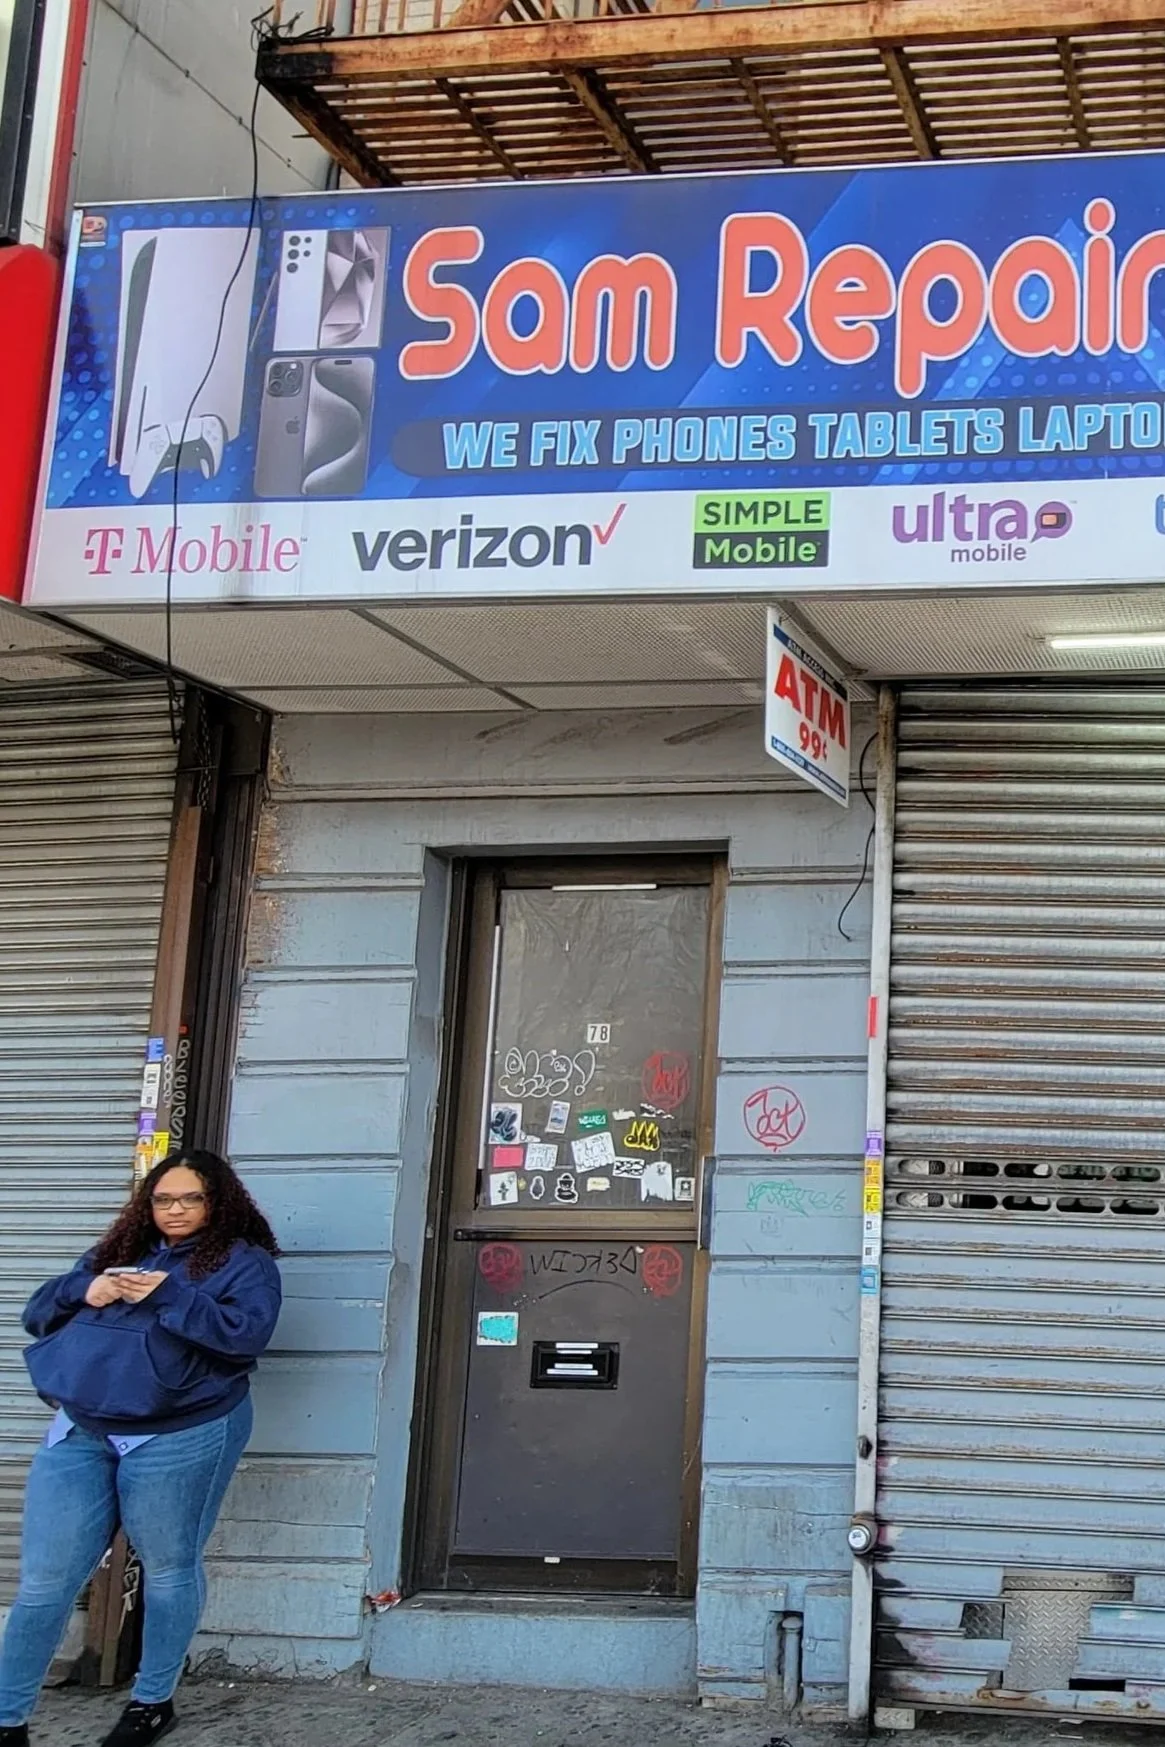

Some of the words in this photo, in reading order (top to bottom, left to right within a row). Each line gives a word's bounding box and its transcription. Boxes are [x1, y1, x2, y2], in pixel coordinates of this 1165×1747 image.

[399, 225, 678, 381] Sam
[442, 420, 518, 469] WE
[530, 418, 599, 465] FIX
[612, 415, 796, 463] PHONES
[809, 408, 1005, 459] TABLETS
[702, 499, 823, 526] SIMPLE
[892, 491, 1021, 544] ultra
[353, 514, 593, 571] verizon
[703, 535, 818, 564] Mobile
[950, 543, 1027, 563] mobile
[774, 653, 846, 750] ATM
[589, 1025, 609, 1042] 78
